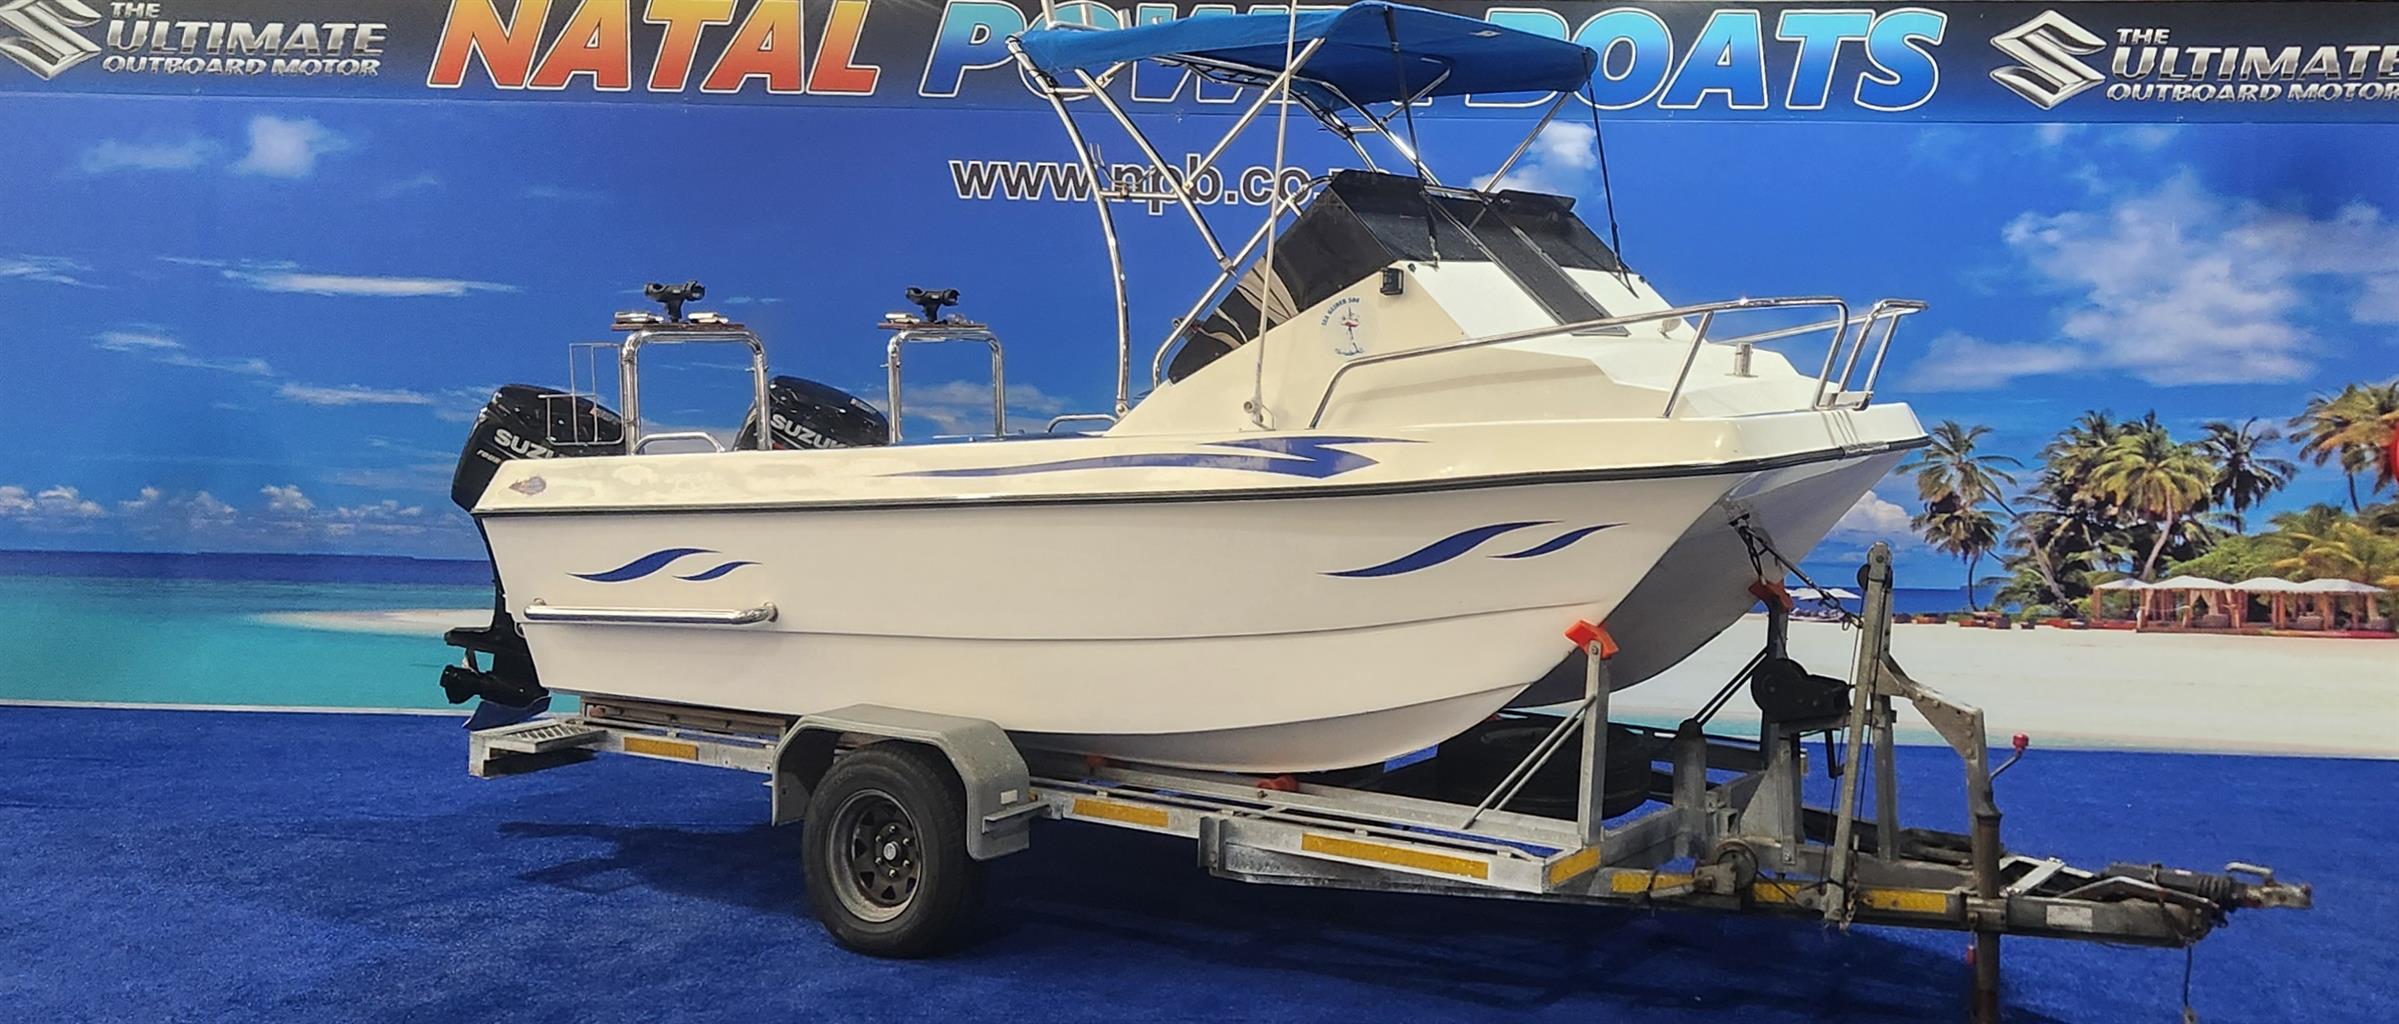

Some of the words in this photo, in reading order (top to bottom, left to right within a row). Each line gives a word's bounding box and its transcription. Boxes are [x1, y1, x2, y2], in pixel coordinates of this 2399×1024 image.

[111, 2, 160, 19] THE
[107, 20, 388, 56] ULTIMATE
[2115, 28, 2170, 45] THE
[102, 55, 267, 76] OUTBOARD
[271, 57, 381, 78] MOTOR
[427, 0, 881, 96] NATAL
[918, 0, 1433, 107] POW
[2106, 82, 2281, 102] OUTBOARD
[2287, 84, 2399, 104] MOTOR
[494, 428, 566, 460] SUZ
[770, 413, 848, 449] SUZU
